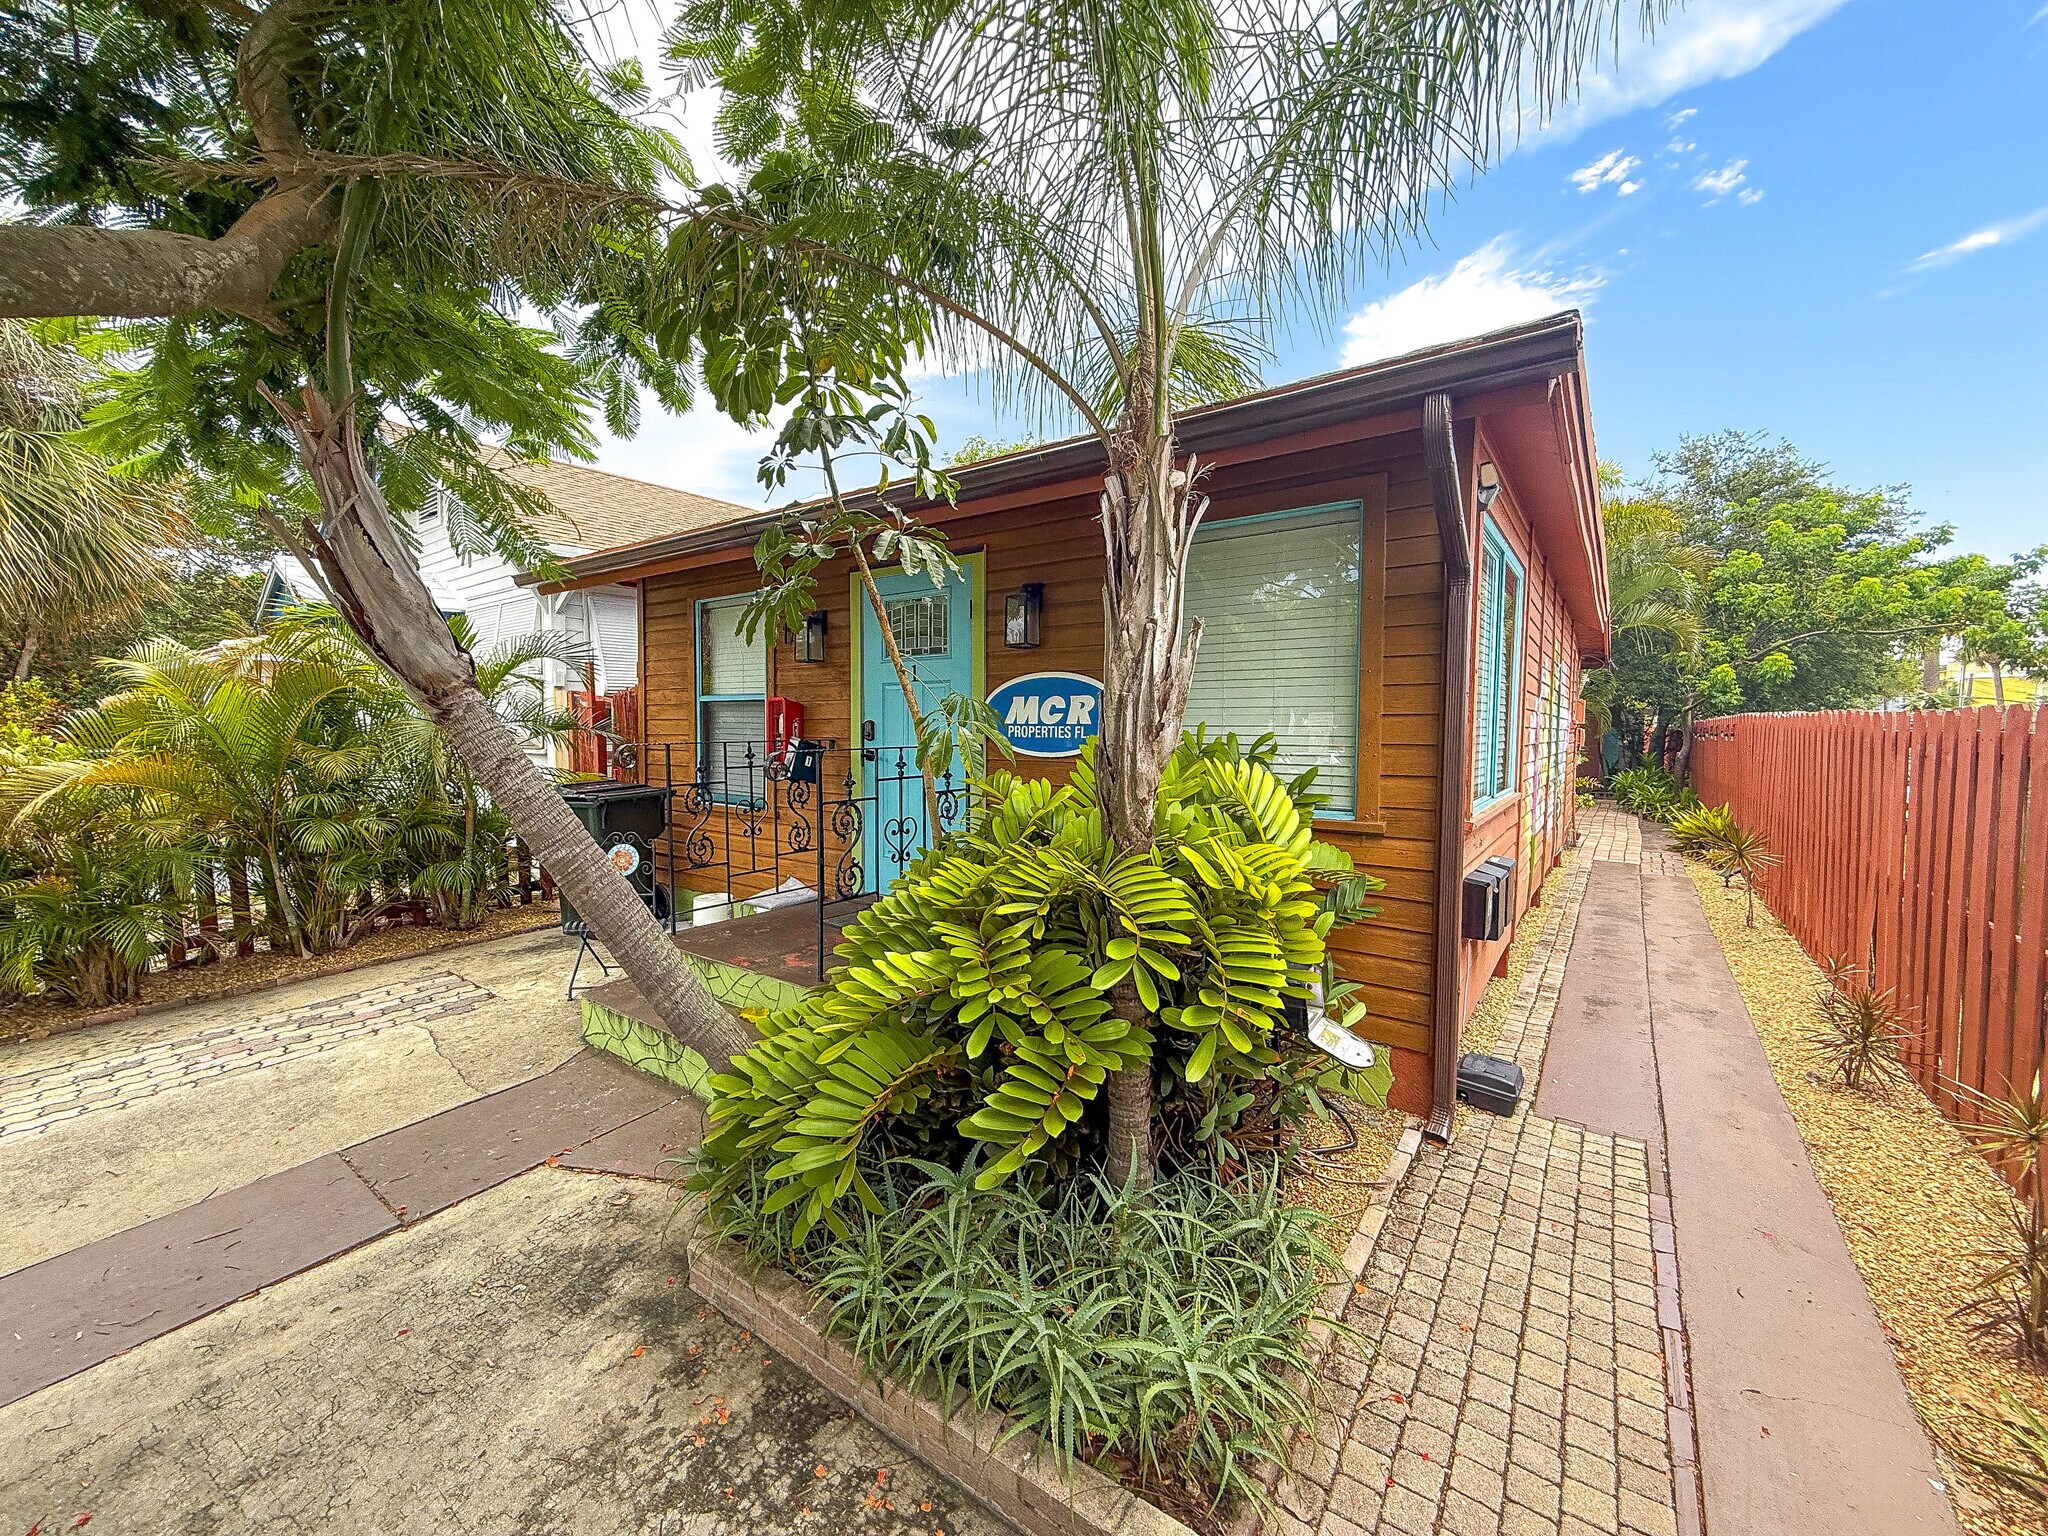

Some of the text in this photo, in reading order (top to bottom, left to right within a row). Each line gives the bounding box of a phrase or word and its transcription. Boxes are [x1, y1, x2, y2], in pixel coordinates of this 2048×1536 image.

[911, 664, 919, 682] 1
[1004, 695, 1096, 725] MCR
[1007, 725, 1072, 739] PROPERTIES
